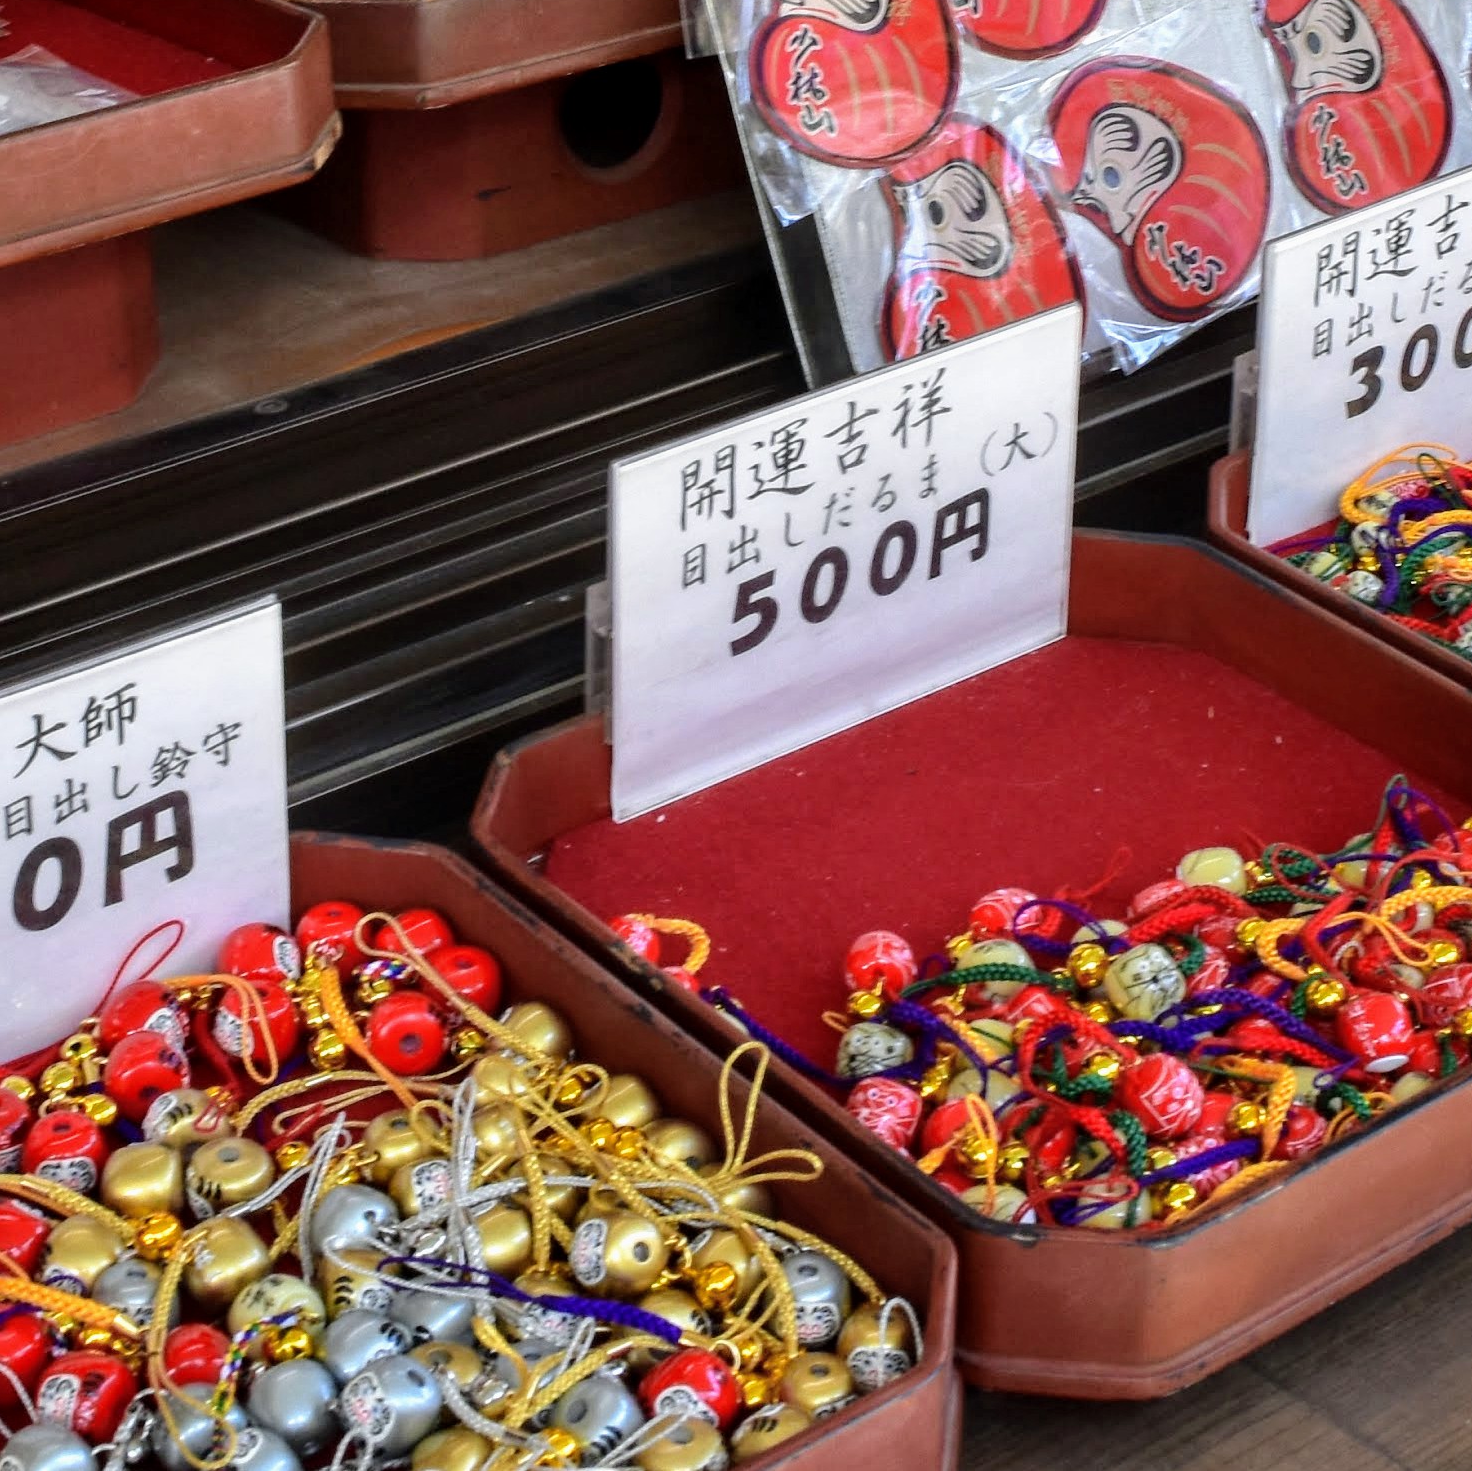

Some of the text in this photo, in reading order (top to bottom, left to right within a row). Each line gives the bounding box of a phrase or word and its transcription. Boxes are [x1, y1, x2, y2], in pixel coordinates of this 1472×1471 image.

[914, 278, 955, 355] 少林
[677, 367, 955, 534] 開運吉祥
[679, 452, 944, 592] 目出しだるま
[728, 485, 992, 660] 500円
